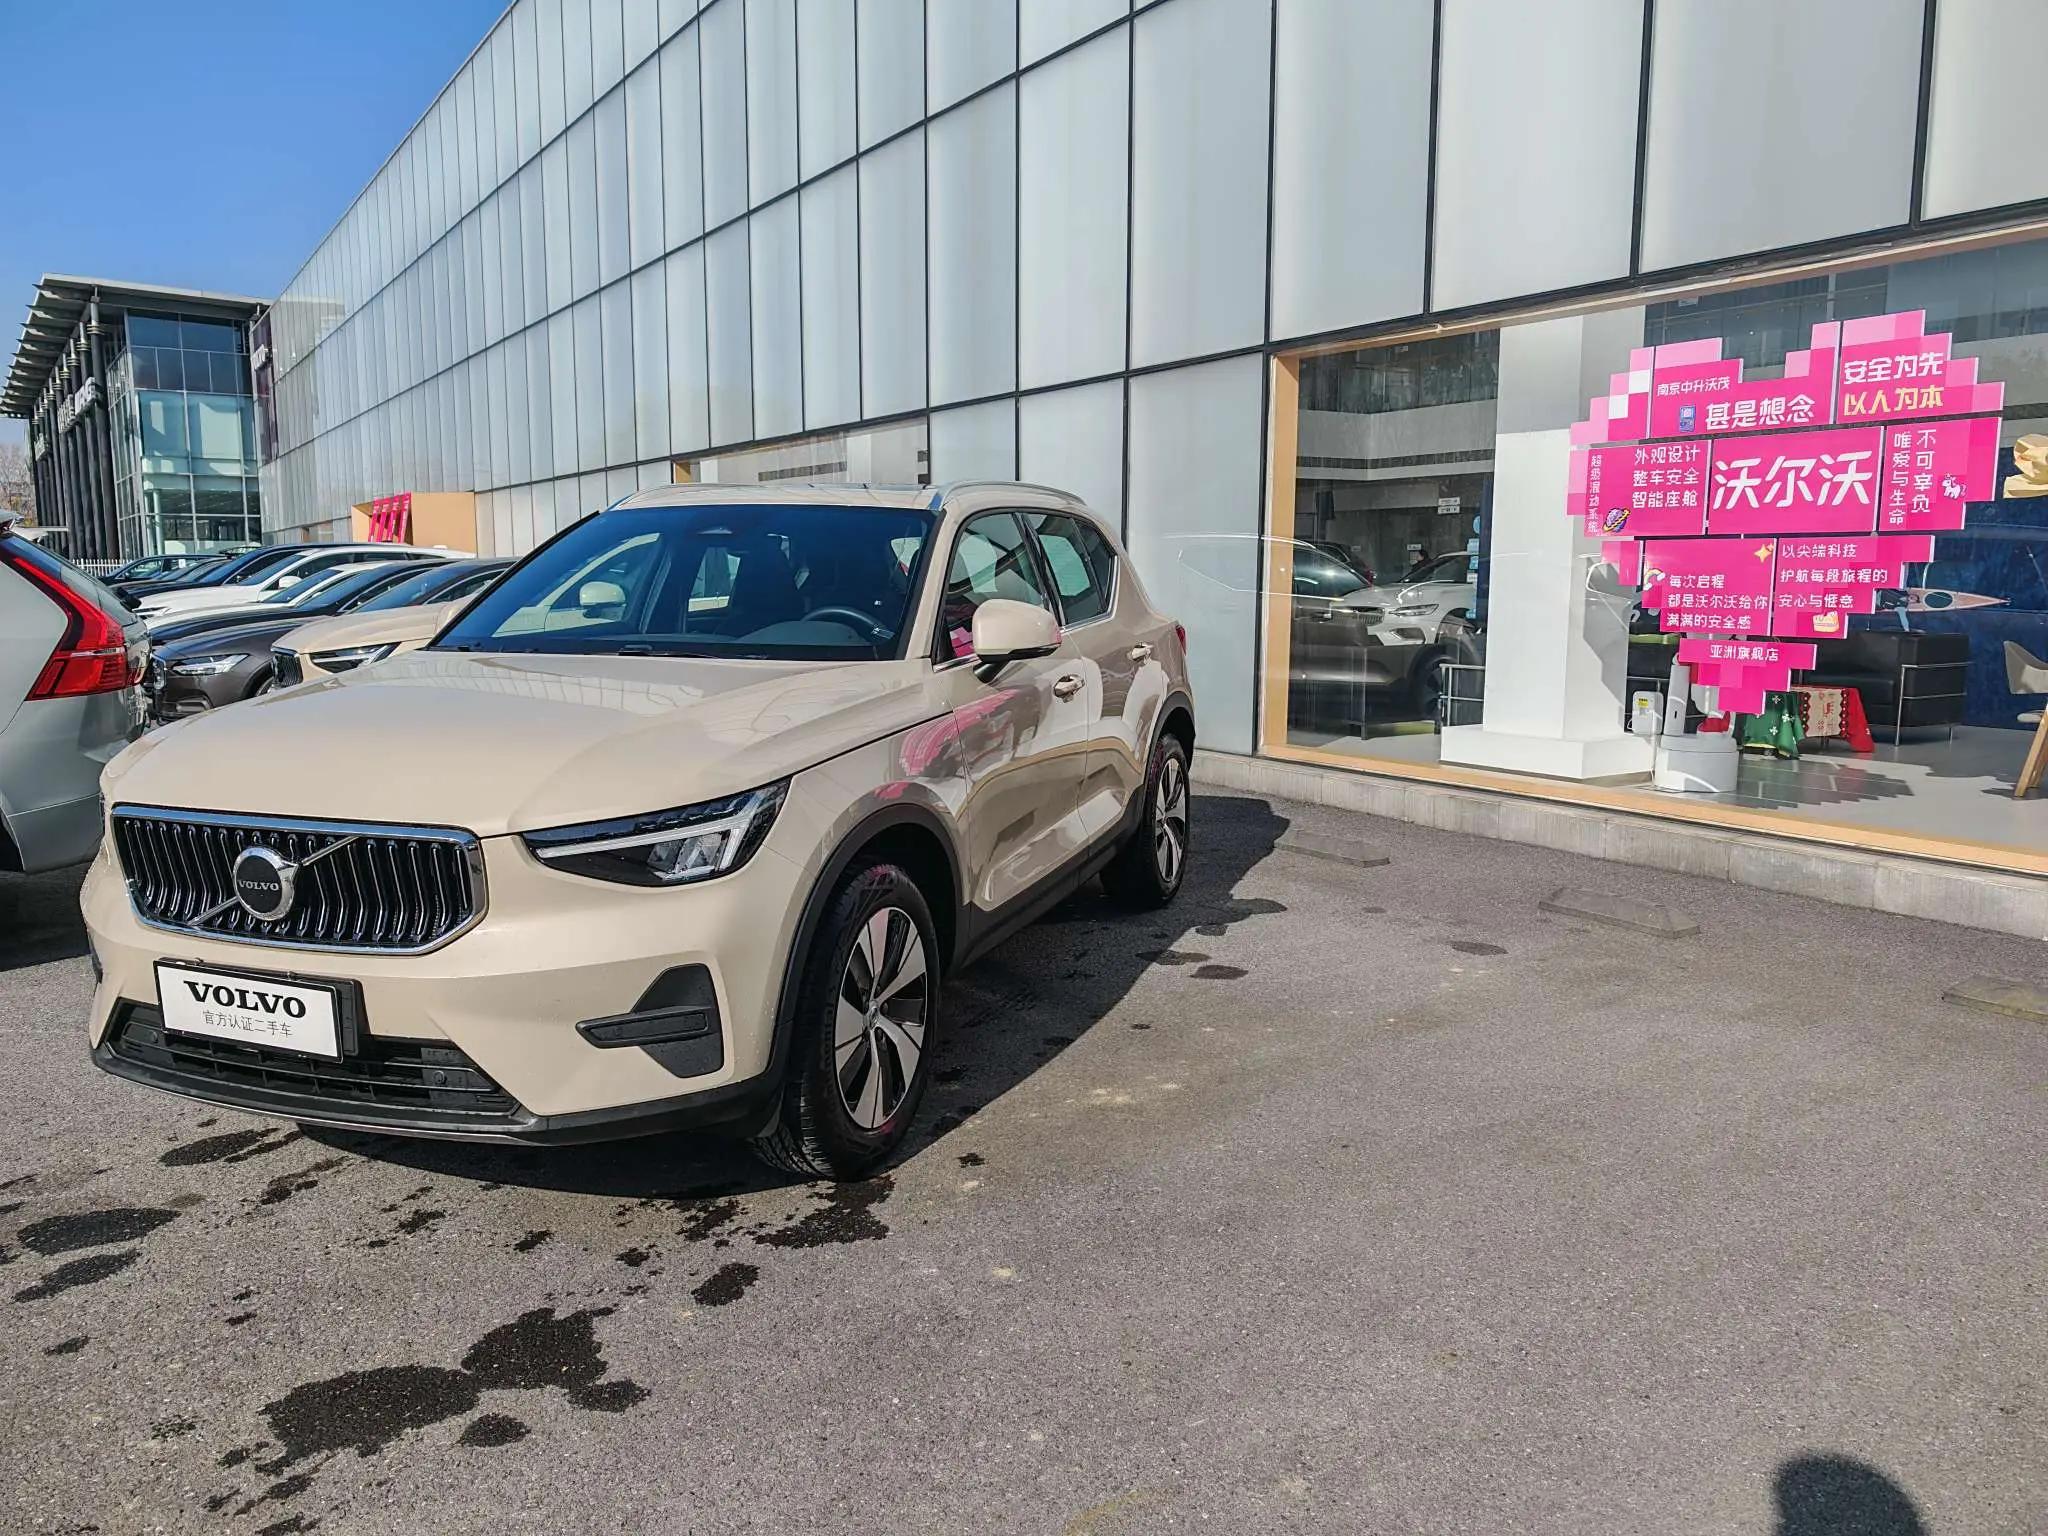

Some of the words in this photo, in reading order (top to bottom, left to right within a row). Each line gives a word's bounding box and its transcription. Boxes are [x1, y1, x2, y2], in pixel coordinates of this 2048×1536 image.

[1844, 352, 1944, 384] 安全为先
[1656, 376, 1731, 397] 南京中升沃茂
[1843, 384, 1945, 416] 以人为本
[1704, 394, 1816, 431] 甚是想念
[1634, 444, 1701, 466] 外观设计
[1632, 467, 1700, 487] 整车安全
[1712, 451, 1873, 510] 沃尔沃
[1888, 431, 1913, 526] 唯爱与生命
[1911, 429, 1937, 513] 不可辜负
[1632, 489, 1699, 508] 智能座舱
[1781, 543, 1858, 559] 以尖端科技
[1669, 574, 1726, 590] 每次启程
[1780, 568, 1888, 584] 护航每段旅程的
[1667, 593, 1769, 610] 都是沃尔沃给你
[1666, 613, 1752, 630] 满满的安全感
[1709, 644, 1780, 662] 亚洲旗舰店
[239, 880, 280, 891] VOLVO
[183, 980, 306, 1019] VOLVO
[202, 1010, 294, 1039] 官方认证二手车
